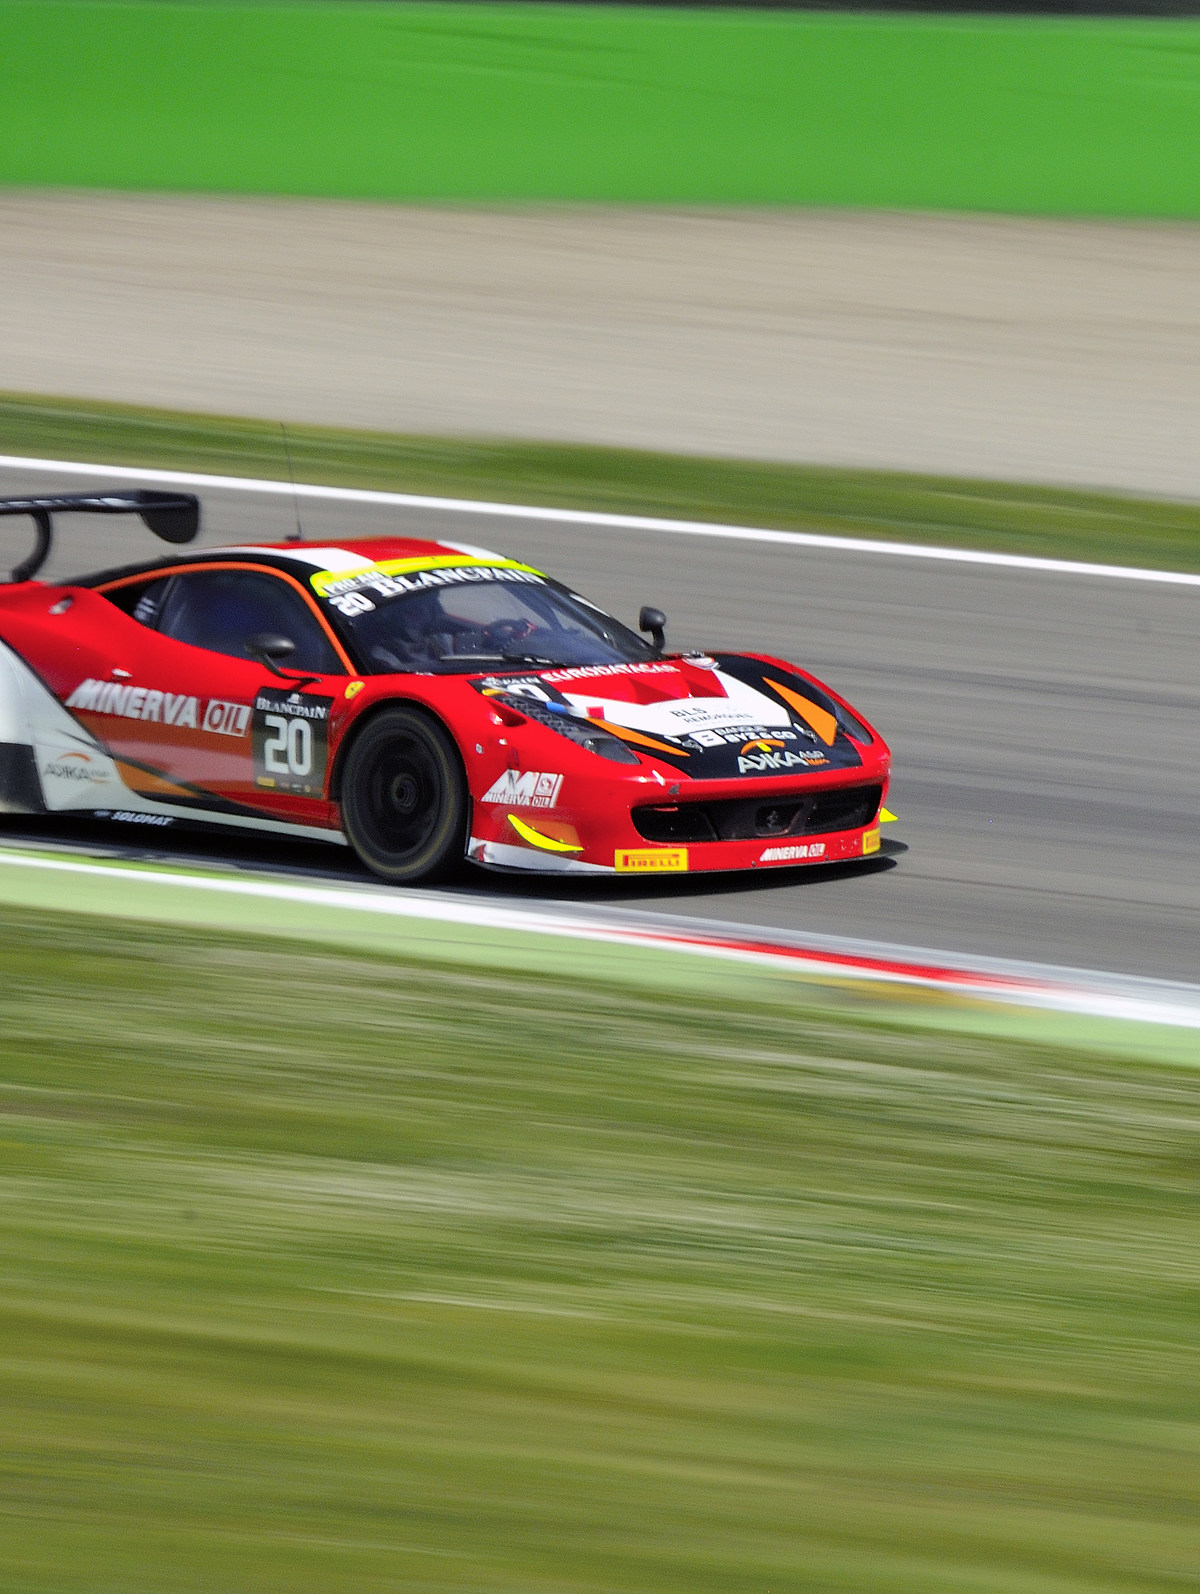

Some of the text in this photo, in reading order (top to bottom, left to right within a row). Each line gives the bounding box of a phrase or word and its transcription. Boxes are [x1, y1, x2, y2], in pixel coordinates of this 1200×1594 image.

[370, 566, 549, 598] BLANCPAIN
[328, 592, 376, 617] 20
[540, 664, 681, 682] EURODATACAR
[65, 678, 247, 735] MINERVA OIL
[256, 697, 326, 719] BLANCPAIN
[670, 707, 707, 718] BLS
[264, 714, 312, 776] 20
[531, 796, 550, 808] OIL
[623, 854, 680, 867] PIRELLI
[759, 845, 808, 861] MINERVA
